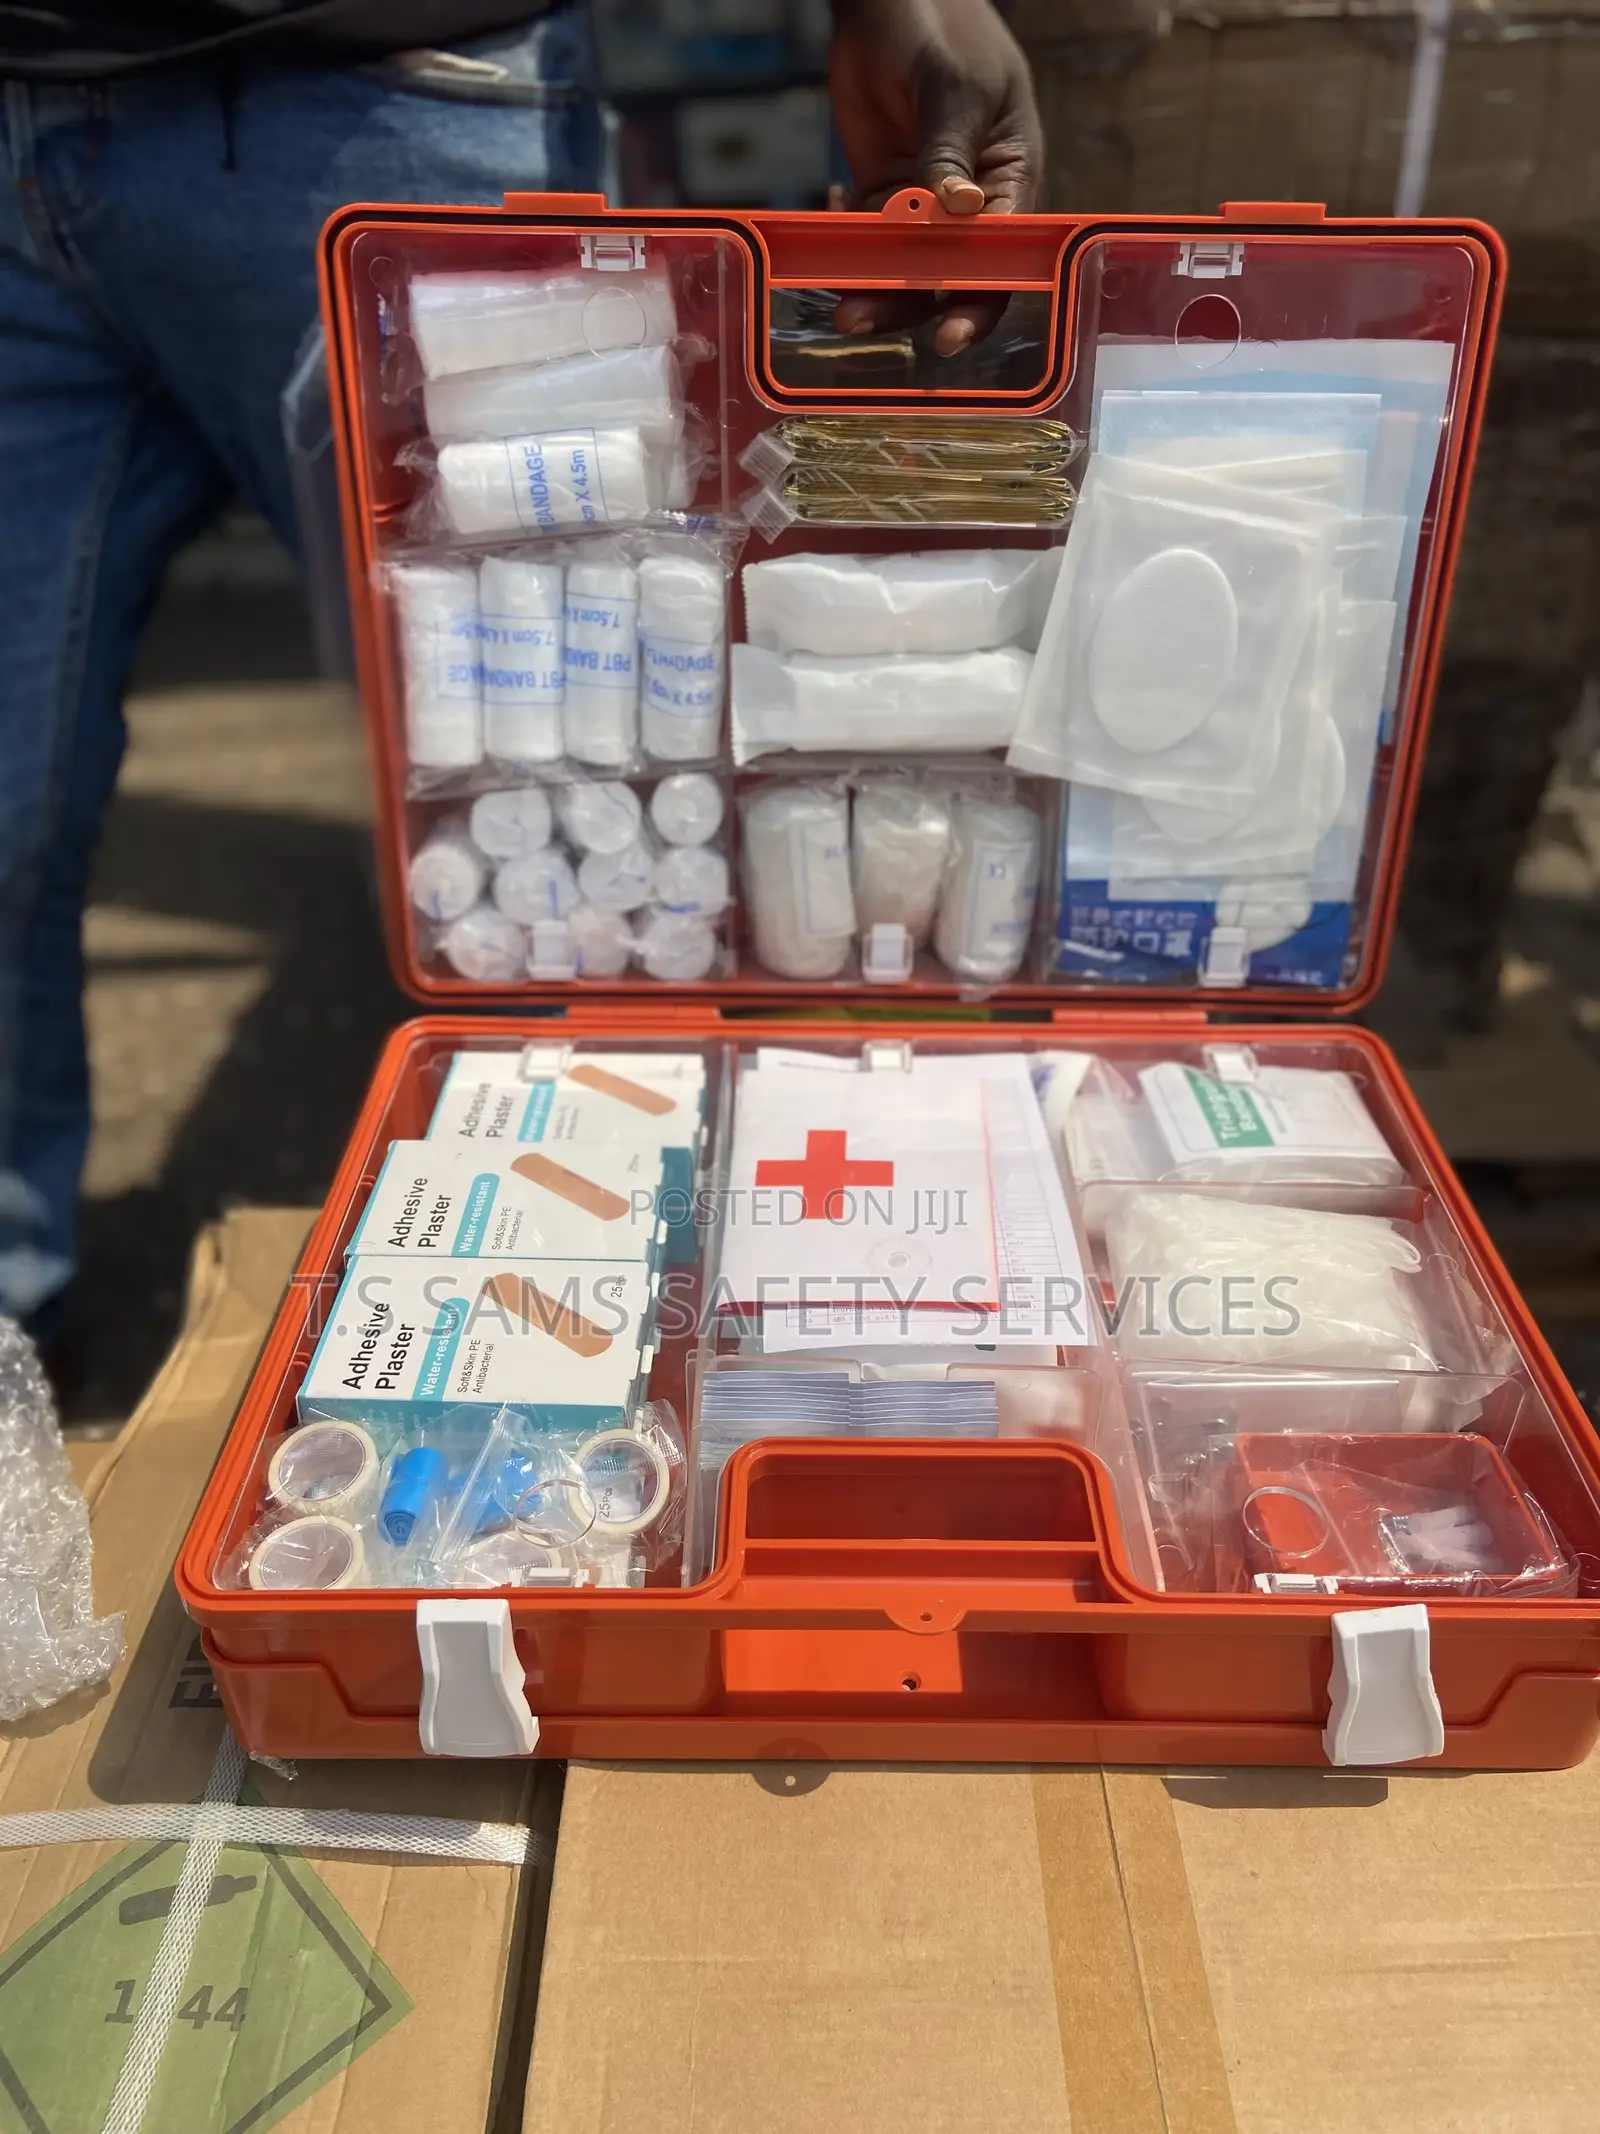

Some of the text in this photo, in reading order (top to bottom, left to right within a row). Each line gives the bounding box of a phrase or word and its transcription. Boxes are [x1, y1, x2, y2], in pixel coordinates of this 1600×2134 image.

[524, 445, 555, 524] BANDAGE
[570, 449, 588, 487] 4.5m
[602, 652, 632, 673] PBT
[458, 1081, 492, 1139] Adhesive
[485, 1094, 514, 1139] Plaster
[387, 1176, 429, 1249] Adhesive
[417, 1194, 452, 1249] Plaster
[458, 1181, 491, 1254] Water-resistant
[505, 1210, 524, 1251] Antibacterial
[341, 1302, 390, 1390] Adhesive
[374, 1323, 416, 1391] Plaster
[420, 1306, 461, 1396] Water-resistant
[457, 1339, 481, 1394] Soft&Skin PE
[472, 1343, 495, 1394] Antibacterial
[598, 1487, 613, 1518] 25Pcs
